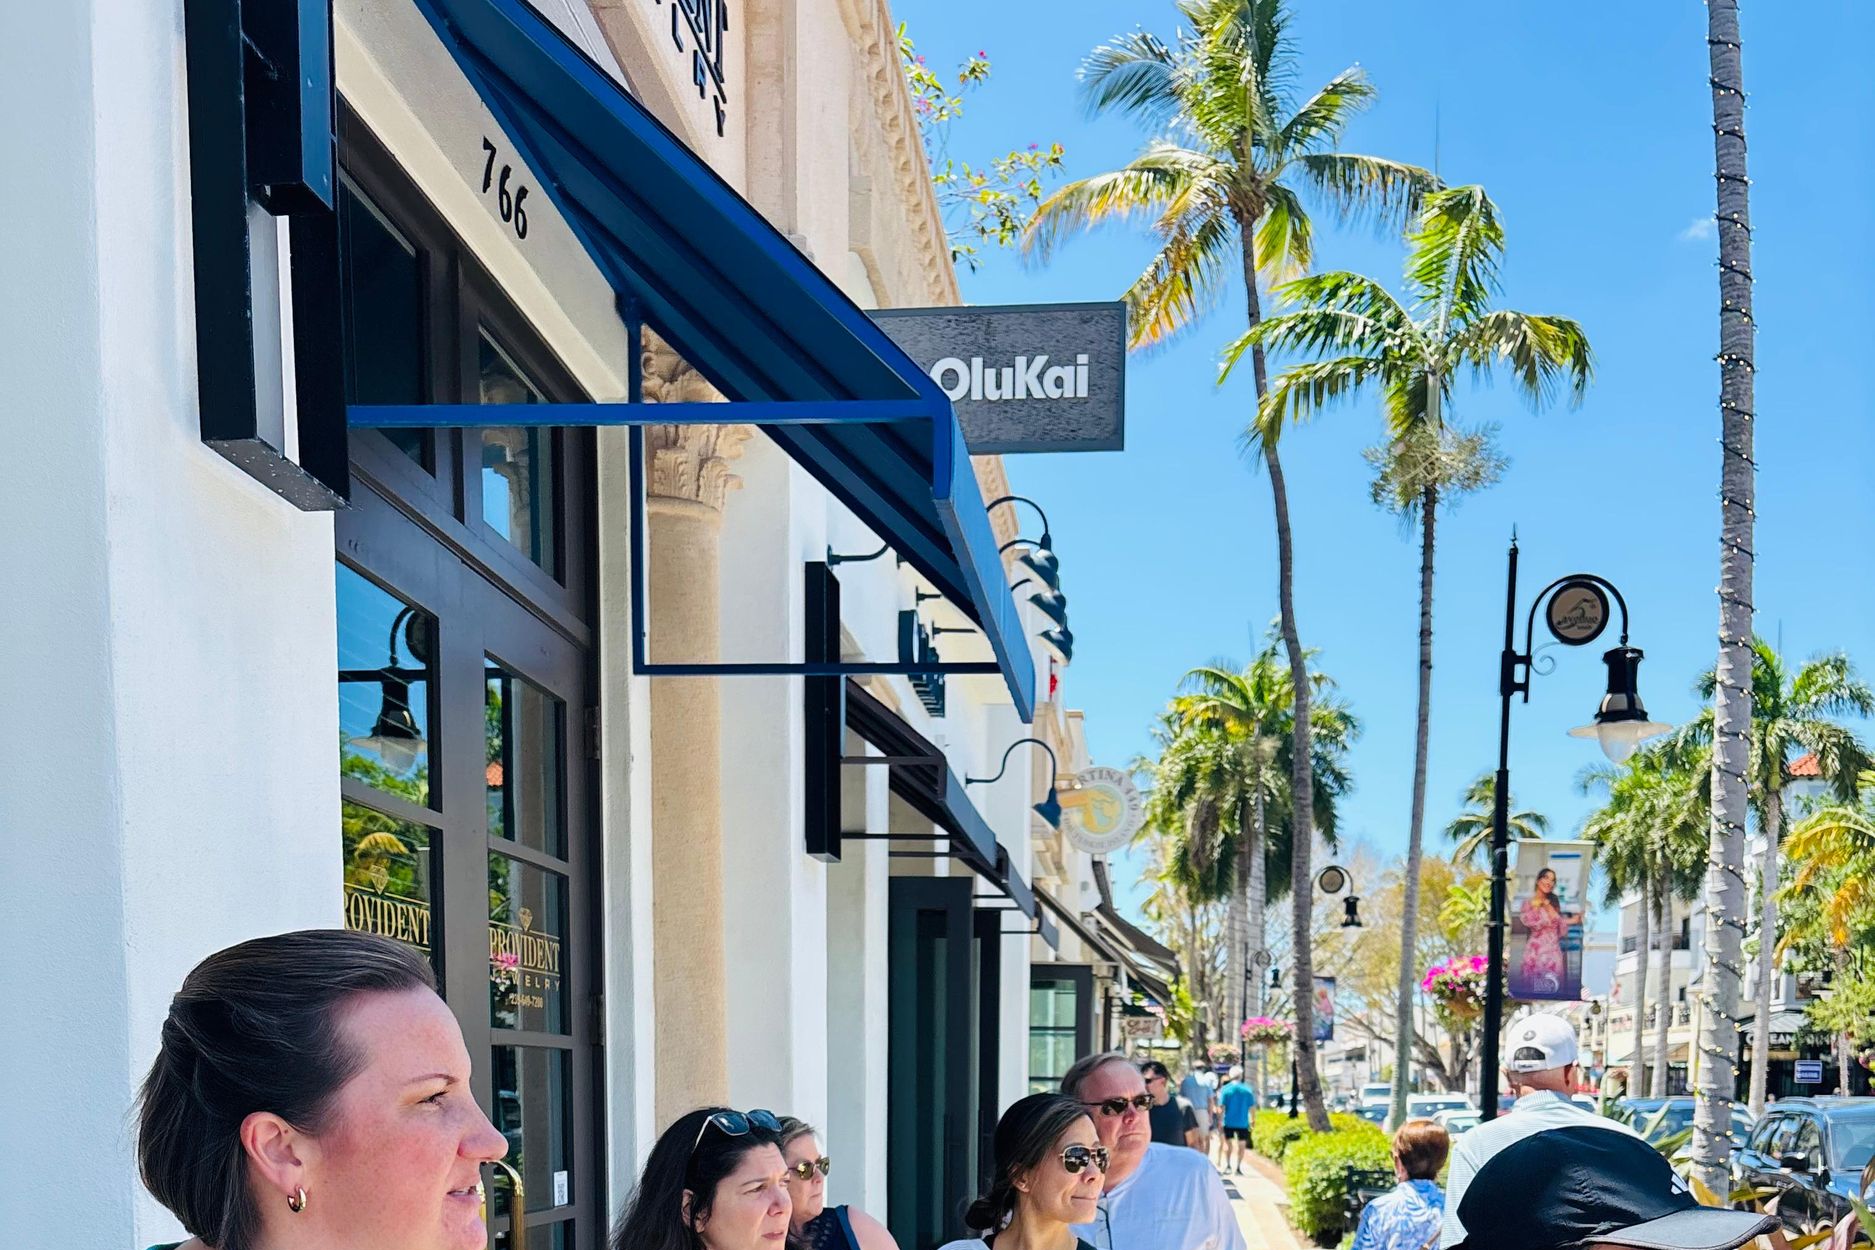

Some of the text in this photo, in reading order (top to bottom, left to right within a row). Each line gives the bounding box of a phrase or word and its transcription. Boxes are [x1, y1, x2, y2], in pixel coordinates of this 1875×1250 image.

[482, 136, 529, 240] 766
[930, 354, 1090, 401] OluKai
[344, 890, 432, 945] ROVIDENT
[489, 926, 560, 973] PROVIDENT
[490, 966, 560, 992] JEWELRY
[1745, 1033, 1794, 1045] OEAN
